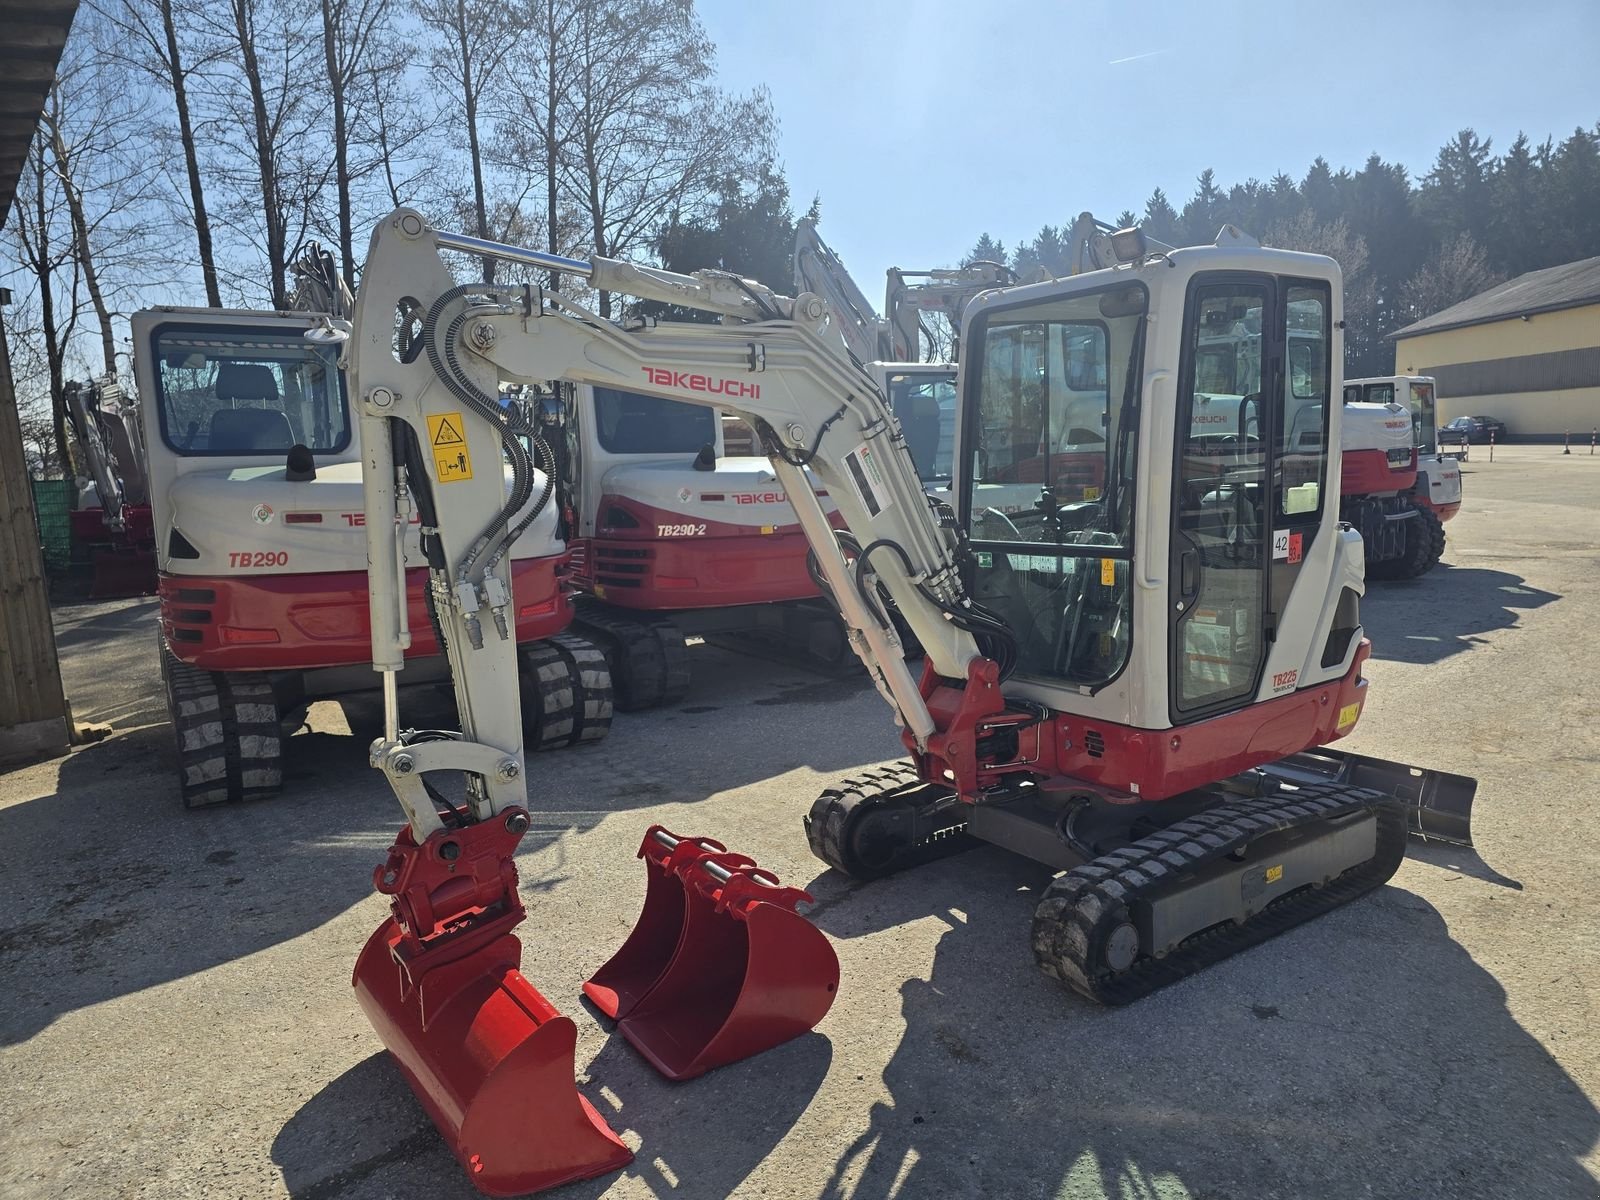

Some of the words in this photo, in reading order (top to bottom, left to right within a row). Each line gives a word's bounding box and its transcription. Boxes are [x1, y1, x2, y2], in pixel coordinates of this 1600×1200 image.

[641, 366, 760, 399] TAKEUCHI
[731, 493, 789, 504] TAKEU
[657, 524, 706, 537] TB290-2
[1275, 536, 1288, 551] 42
[229, 551, 288, 568] TB290
[1273, 669, 1298, 687] TB225
